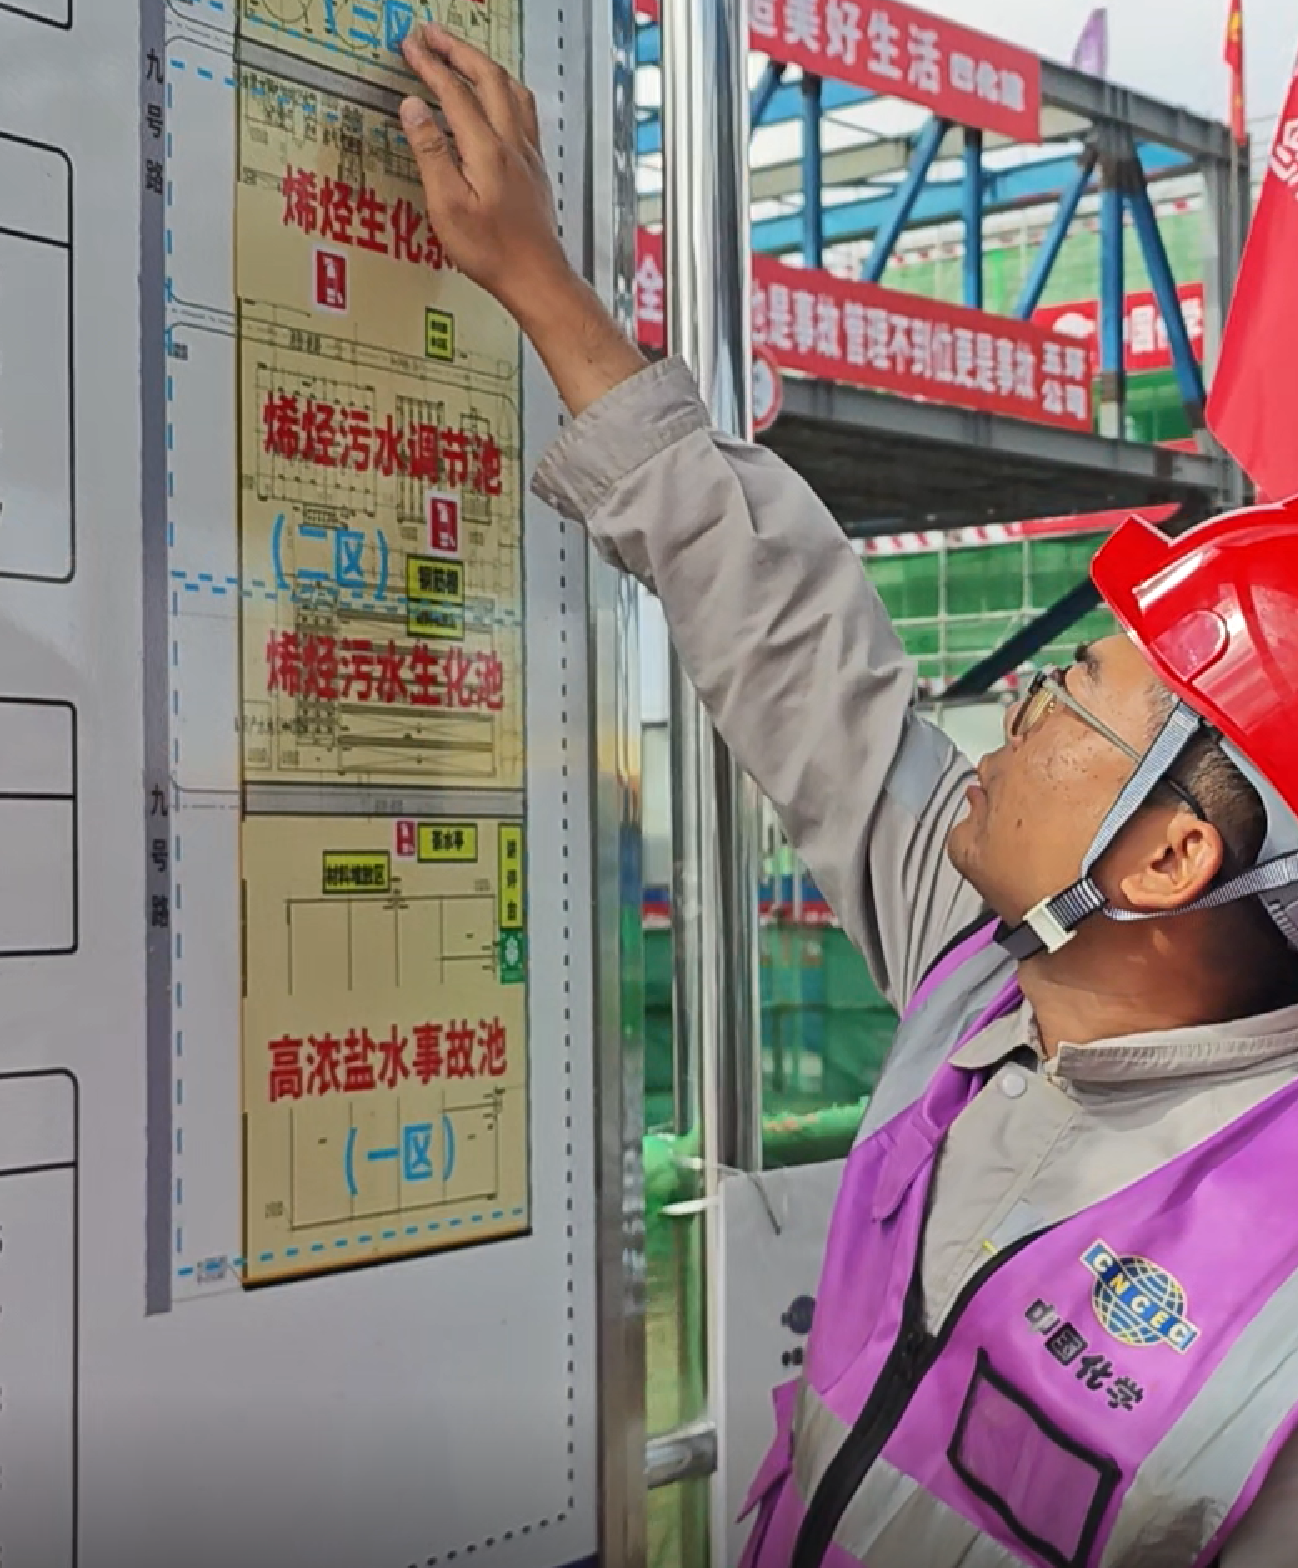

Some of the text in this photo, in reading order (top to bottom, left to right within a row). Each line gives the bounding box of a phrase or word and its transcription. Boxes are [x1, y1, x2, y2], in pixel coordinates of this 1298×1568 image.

[146, 48, 164, 195] 九号路
[263, 391, 503, 496] 烯烃污水调节池
[272, 513, 389, 600] (二区)
[266, 630, 504, 710] 烯烃污水生化池
[151, 785, 168, 928] 九号路
[268, 1016, 508, 1102] 高浓盐水事故池
[345, 1115, 455, 1197] (一区)
[1024, 1298, 1144, 1411] 中国化学
